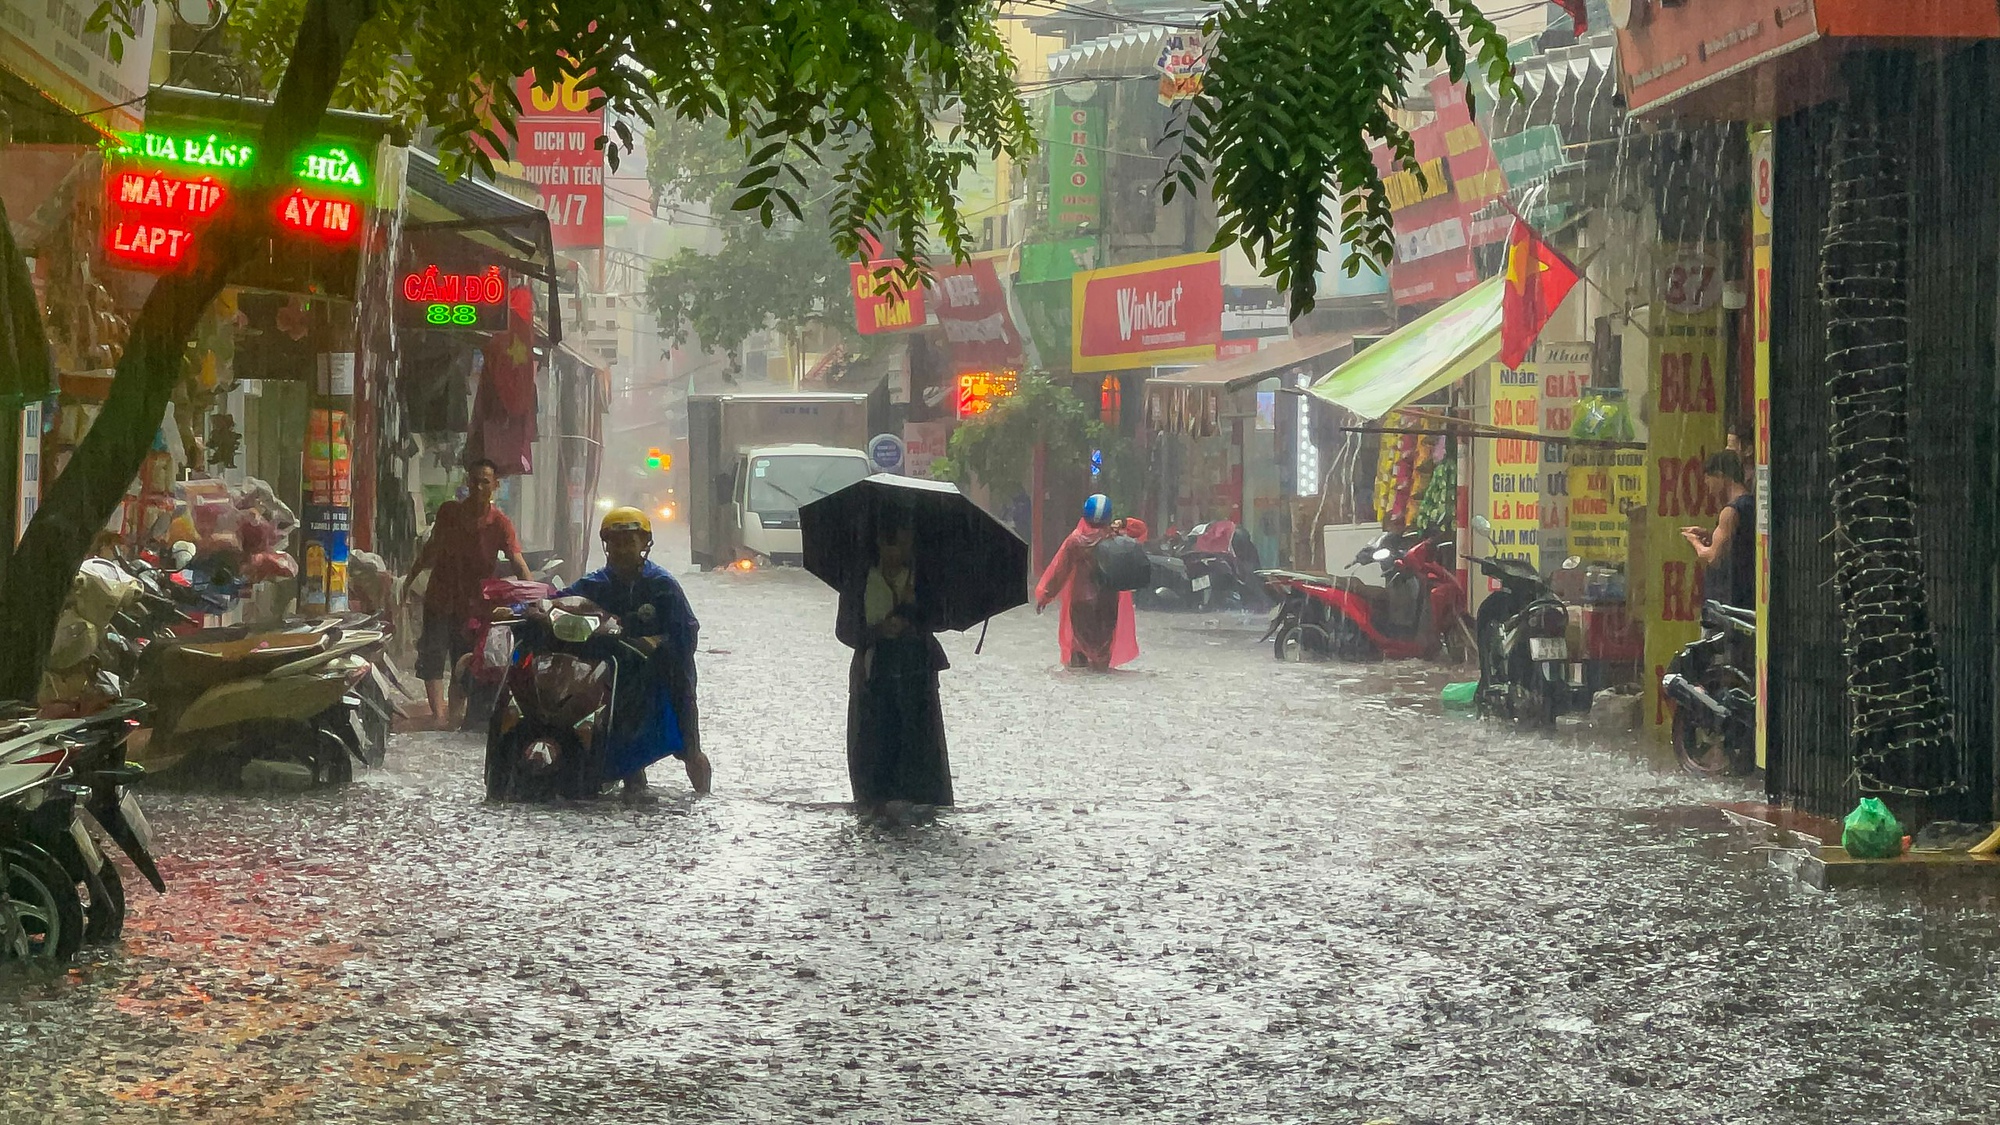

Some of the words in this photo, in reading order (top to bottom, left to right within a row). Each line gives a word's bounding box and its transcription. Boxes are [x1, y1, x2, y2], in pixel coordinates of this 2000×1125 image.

[534, 131, 564, 155] DỊCH
[568, 131, 586, 155] VỤ
[299, 148, 362, 185] HỮA
[522, 157, 569, 185] HUYỂN
[120, 169, 181, 208] MÁY
[284, 188, 320, 227] ÁY
[323, 201, 351, 231] IN
[114, 222, 192, 257] LAPT
[1665, 265, 1717, 306] 87
[427, 304, 477, 325] 88
[1658, 352, 1717, 414] BIA
